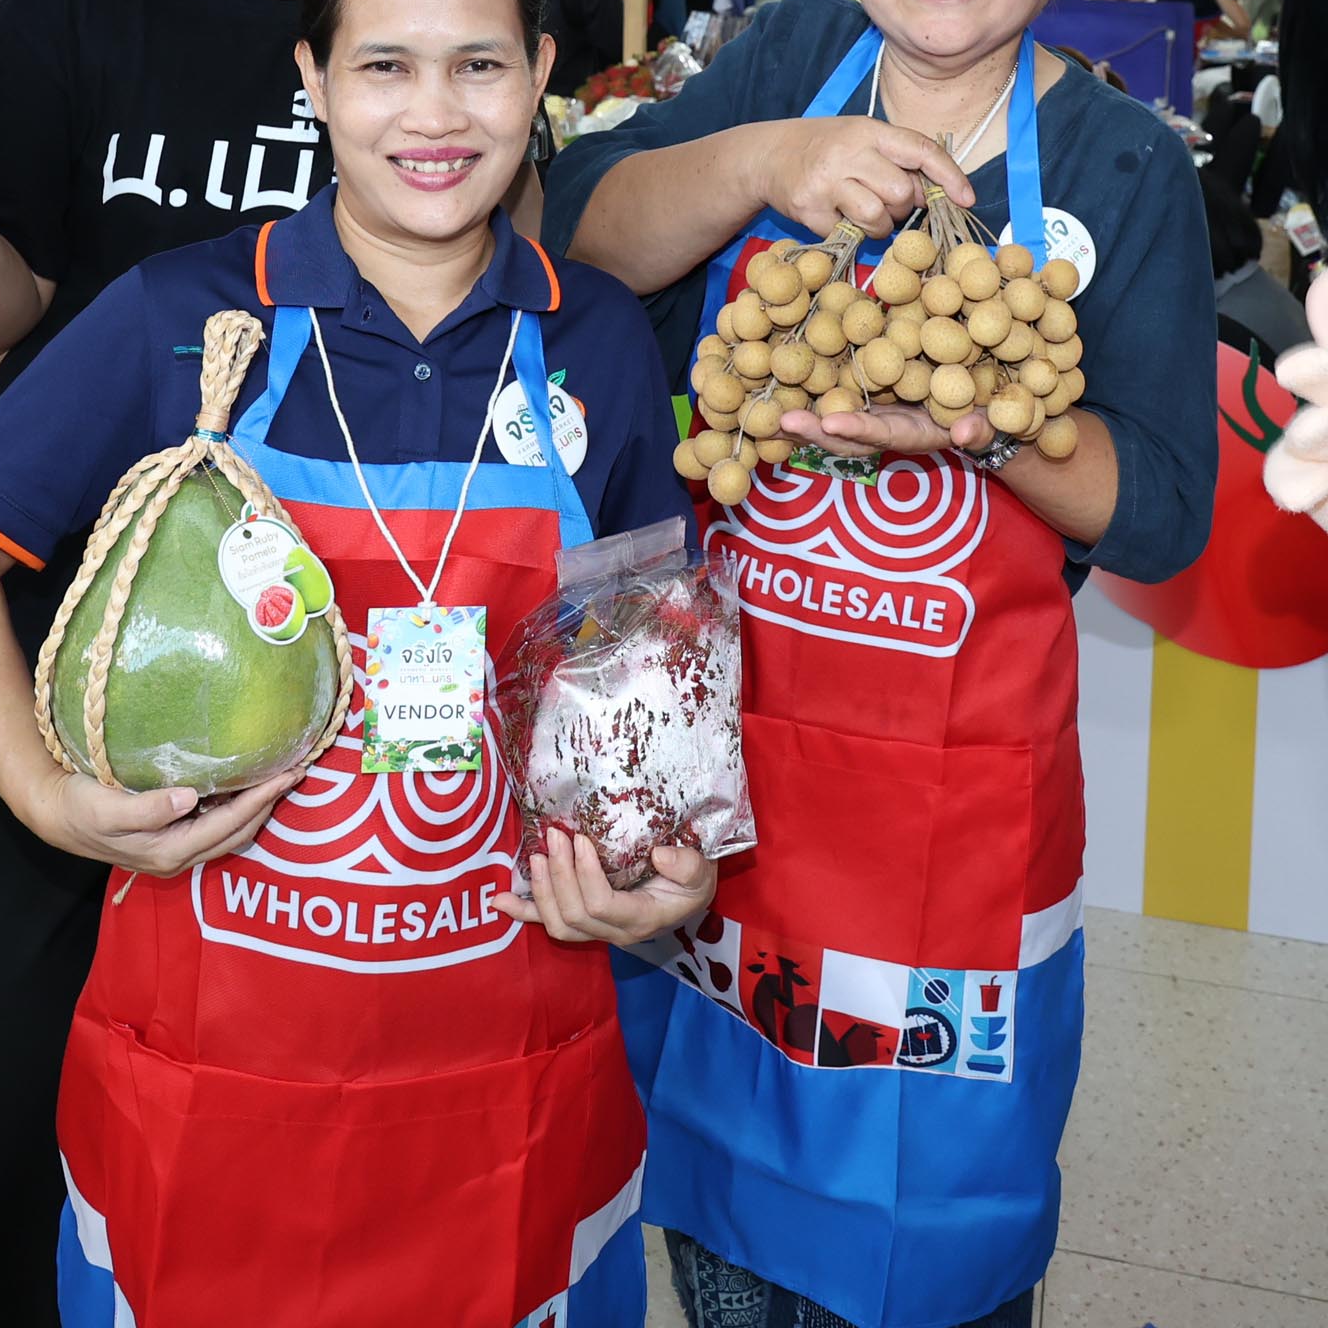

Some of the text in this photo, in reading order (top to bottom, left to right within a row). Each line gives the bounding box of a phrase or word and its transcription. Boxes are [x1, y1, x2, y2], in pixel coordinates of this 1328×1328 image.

[229, 530, 279, 555] Siam Ruby
[241, 545, 278, 565] Pomelo
[721, 544, 947, 634] WHOLESALE
[384, 703, 465, 721] VENDOR
[221, 870, 500, 945] WHOLESALE
